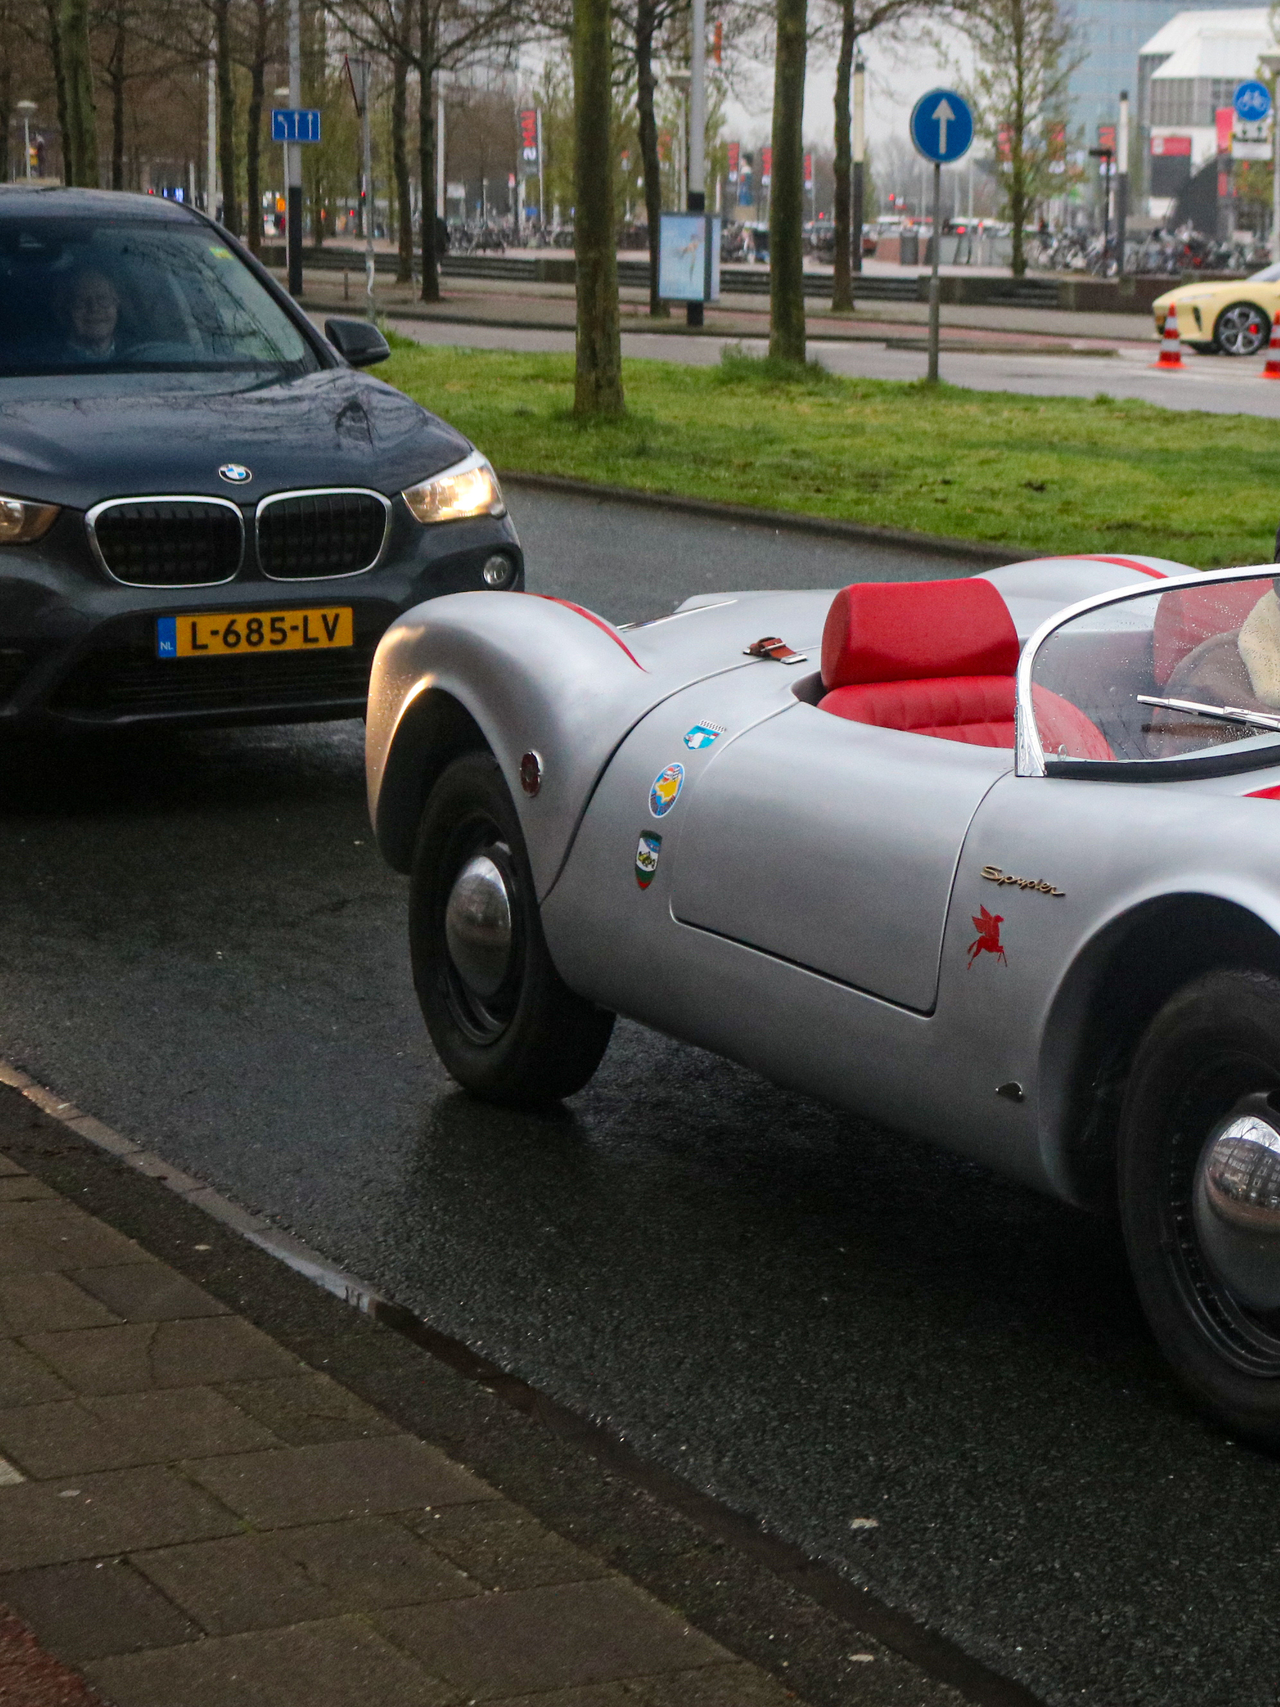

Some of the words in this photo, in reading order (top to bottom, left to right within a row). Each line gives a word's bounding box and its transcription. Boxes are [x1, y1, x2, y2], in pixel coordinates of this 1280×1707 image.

[160, 641, 174, 651] NL
[191, 613, 340, 651] L-685-LV
[980, 865, 1066, 897] Spyder
